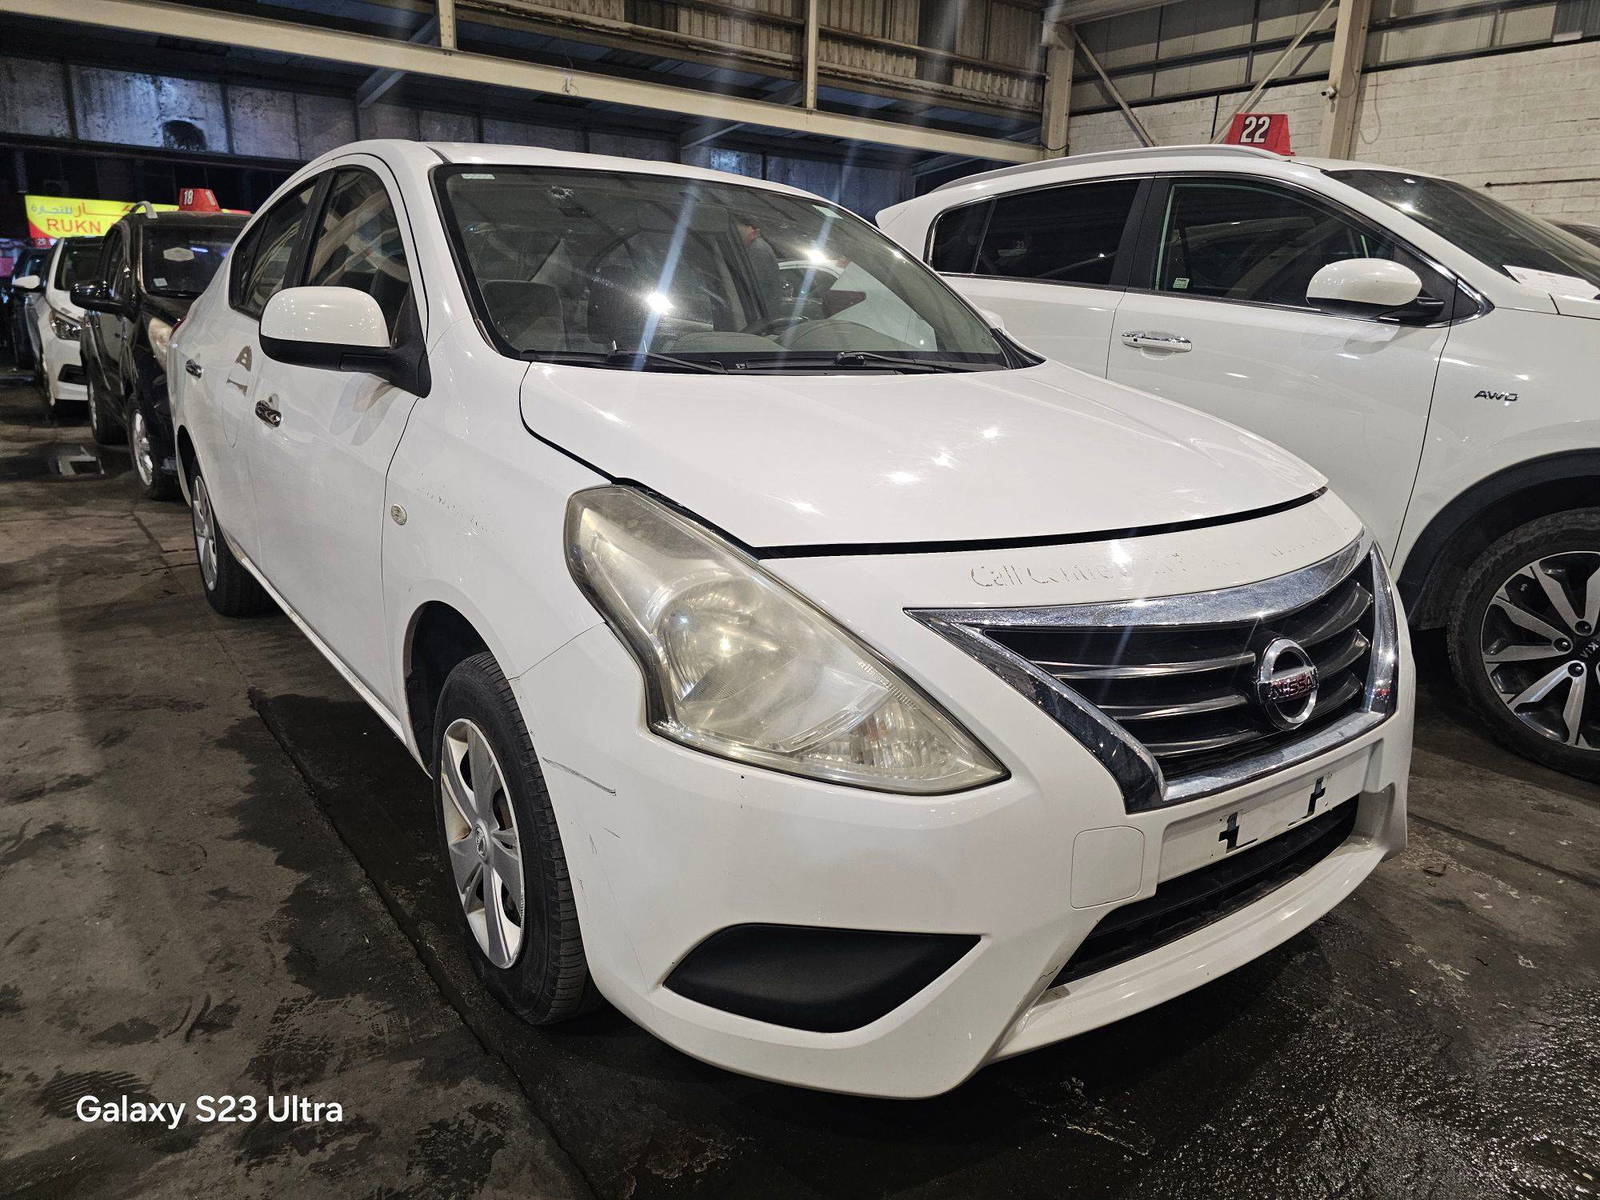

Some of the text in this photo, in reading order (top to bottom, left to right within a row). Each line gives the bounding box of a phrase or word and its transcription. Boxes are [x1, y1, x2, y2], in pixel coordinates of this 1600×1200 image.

[1240, 116, 1270, 143] 22
[184, 189, 194, 205] 18
[46, 218, 101, 234] RUKN
[1473, 390, 1519, 401] AWD
